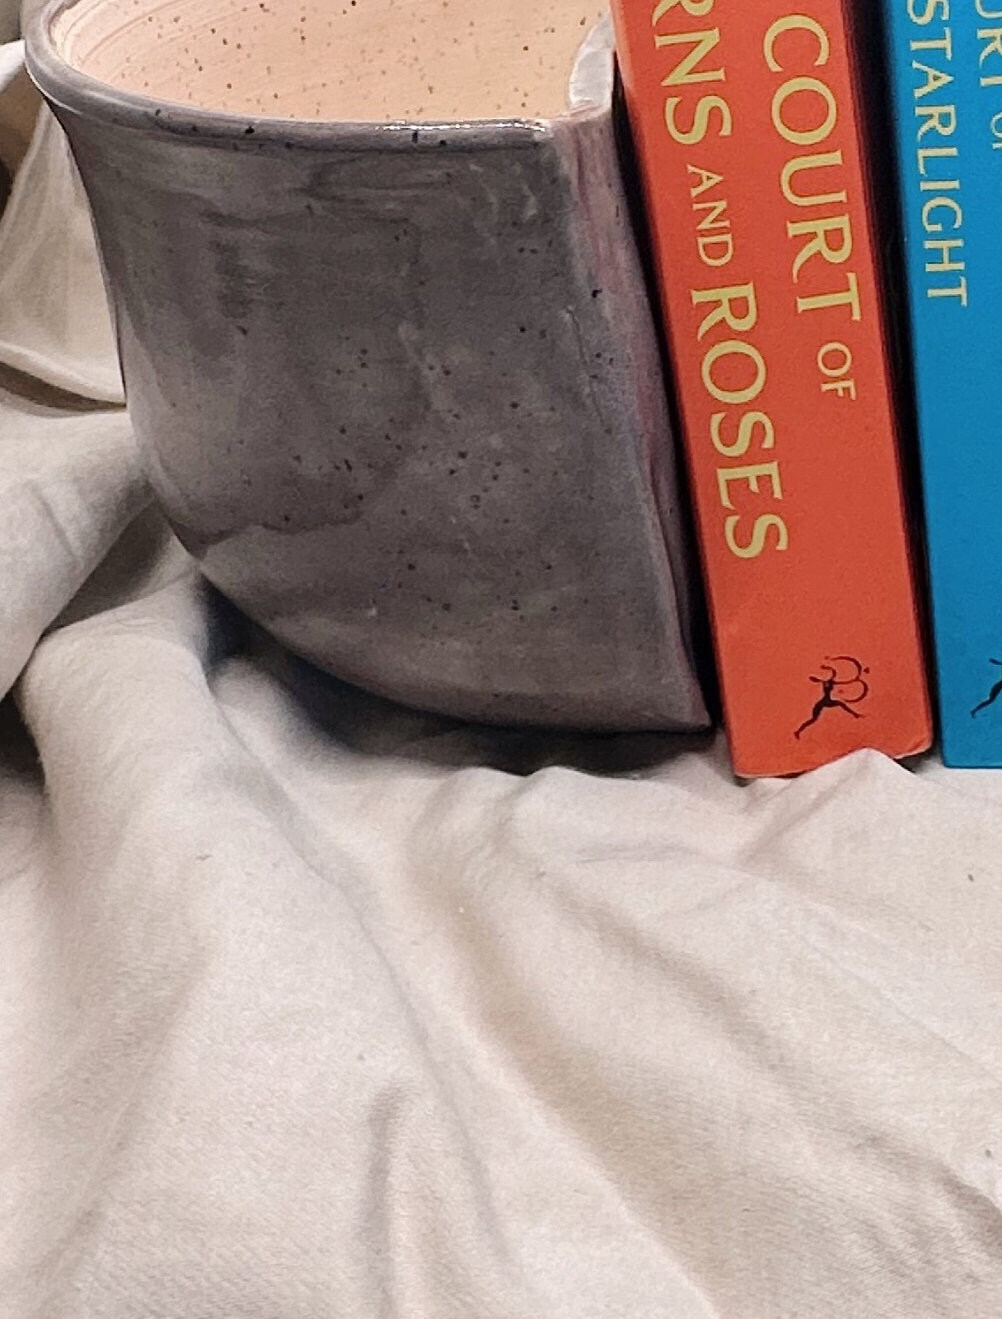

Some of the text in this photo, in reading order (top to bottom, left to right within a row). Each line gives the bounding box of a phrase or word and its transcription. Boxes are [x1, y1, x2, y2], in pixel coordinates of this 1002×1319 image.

[686, 164, 735, 268] AND
[763, 15, 863, 323] COURT
[817, 341, 857, 401] OF
[690, 280, 789, 560] ROSES
